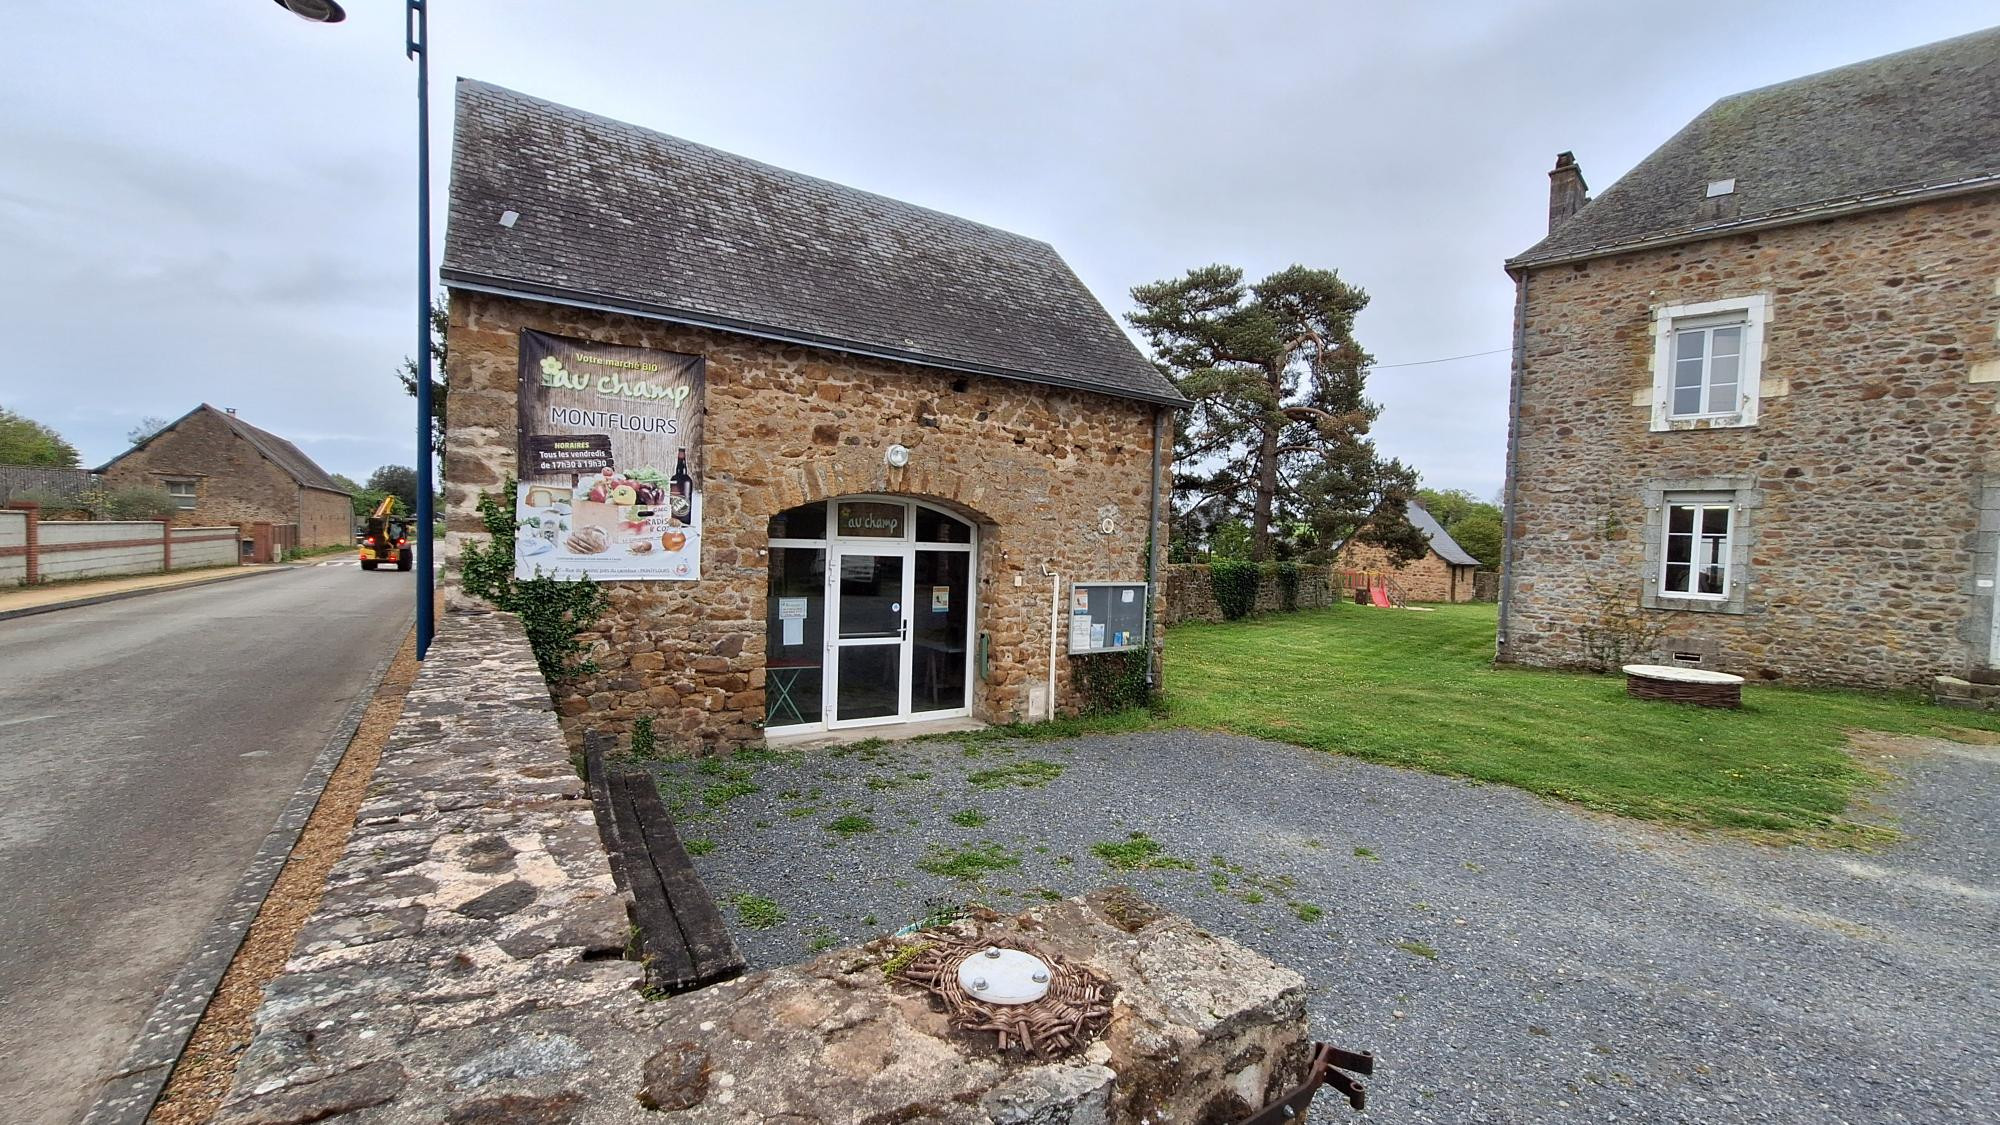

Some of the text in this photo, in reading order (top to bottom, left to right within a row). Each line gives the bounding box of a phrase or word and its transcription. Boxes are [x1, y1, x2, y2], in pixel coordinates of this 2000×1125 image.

[576, 353, 658, 372] Votre marché BIO
[551, 370, 591, 391] au
[597, 372, 690, 408] champ
[551, 407, 677, 434] MONTFLOURS
[539, 449, 605, 459] Tous les vendredis
[554, 441, 590, 449] HORAIRES
[540, 460, 607, 469] de 17h30 à 19h30
[848, 512, 898, 534] au champ
